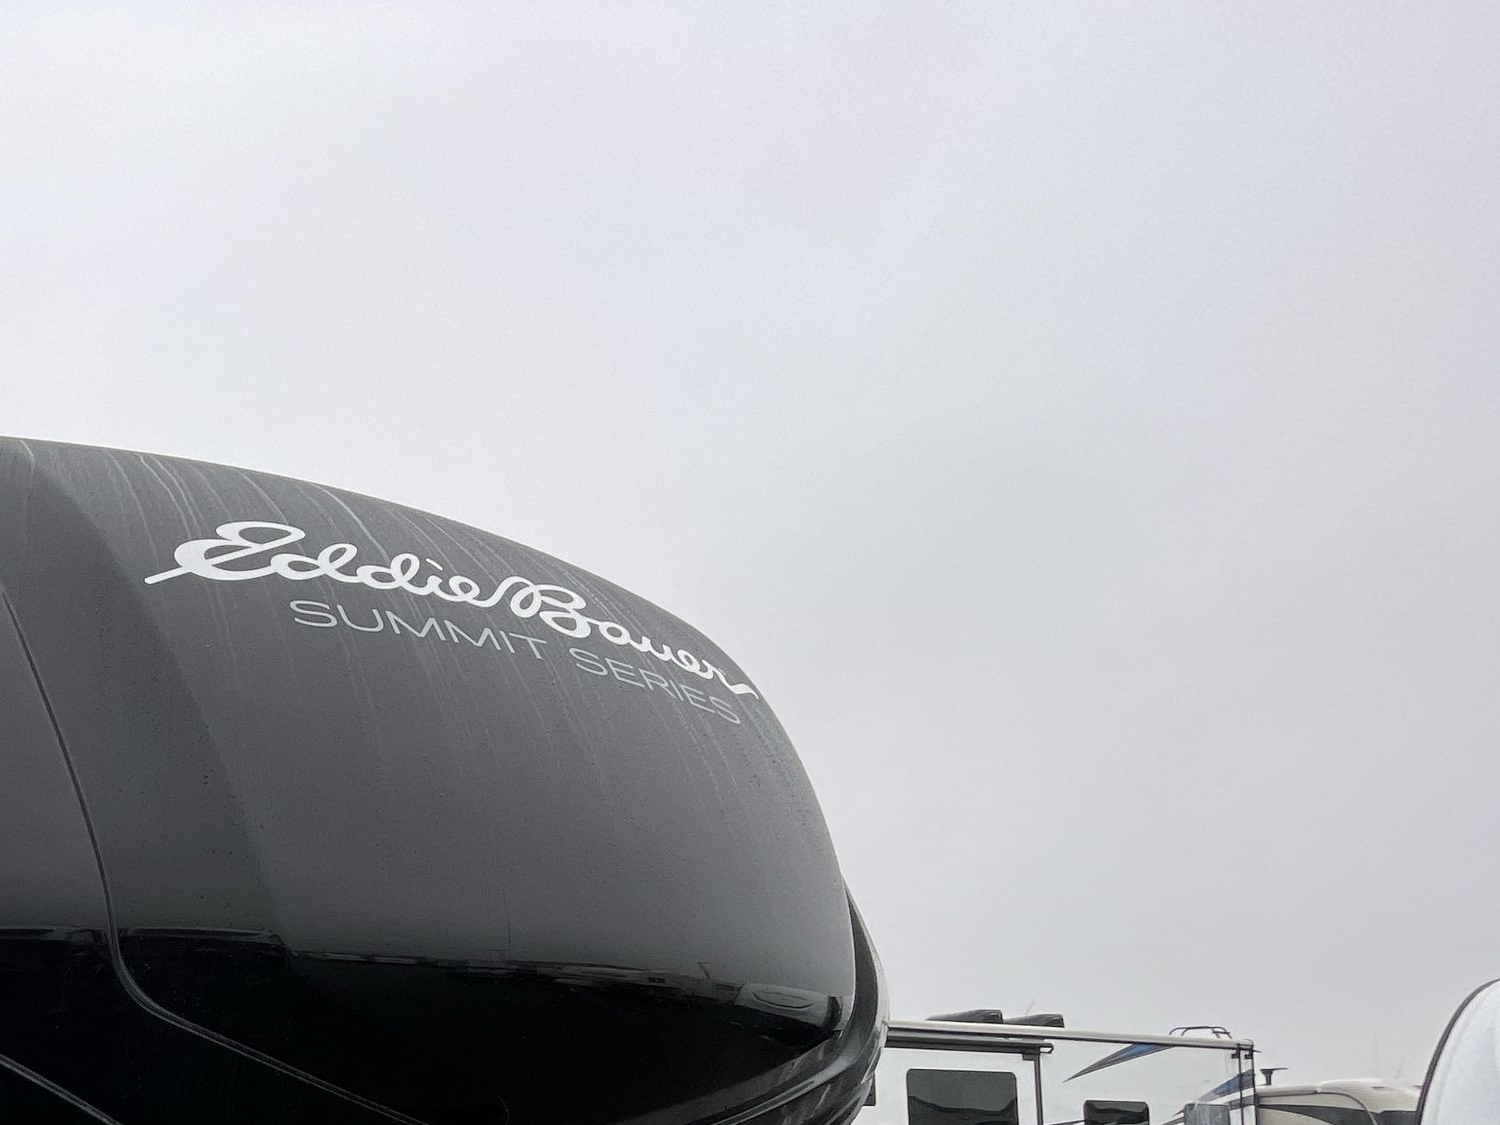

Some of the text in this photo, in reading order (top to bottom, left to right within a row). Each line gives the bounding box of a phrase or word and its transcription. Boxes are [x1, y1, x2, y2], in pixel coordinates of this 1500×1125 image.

[145, 520, 760, 701] Eddie Bauer
[289, 599, 741, 725] SUMMIT SERIES
